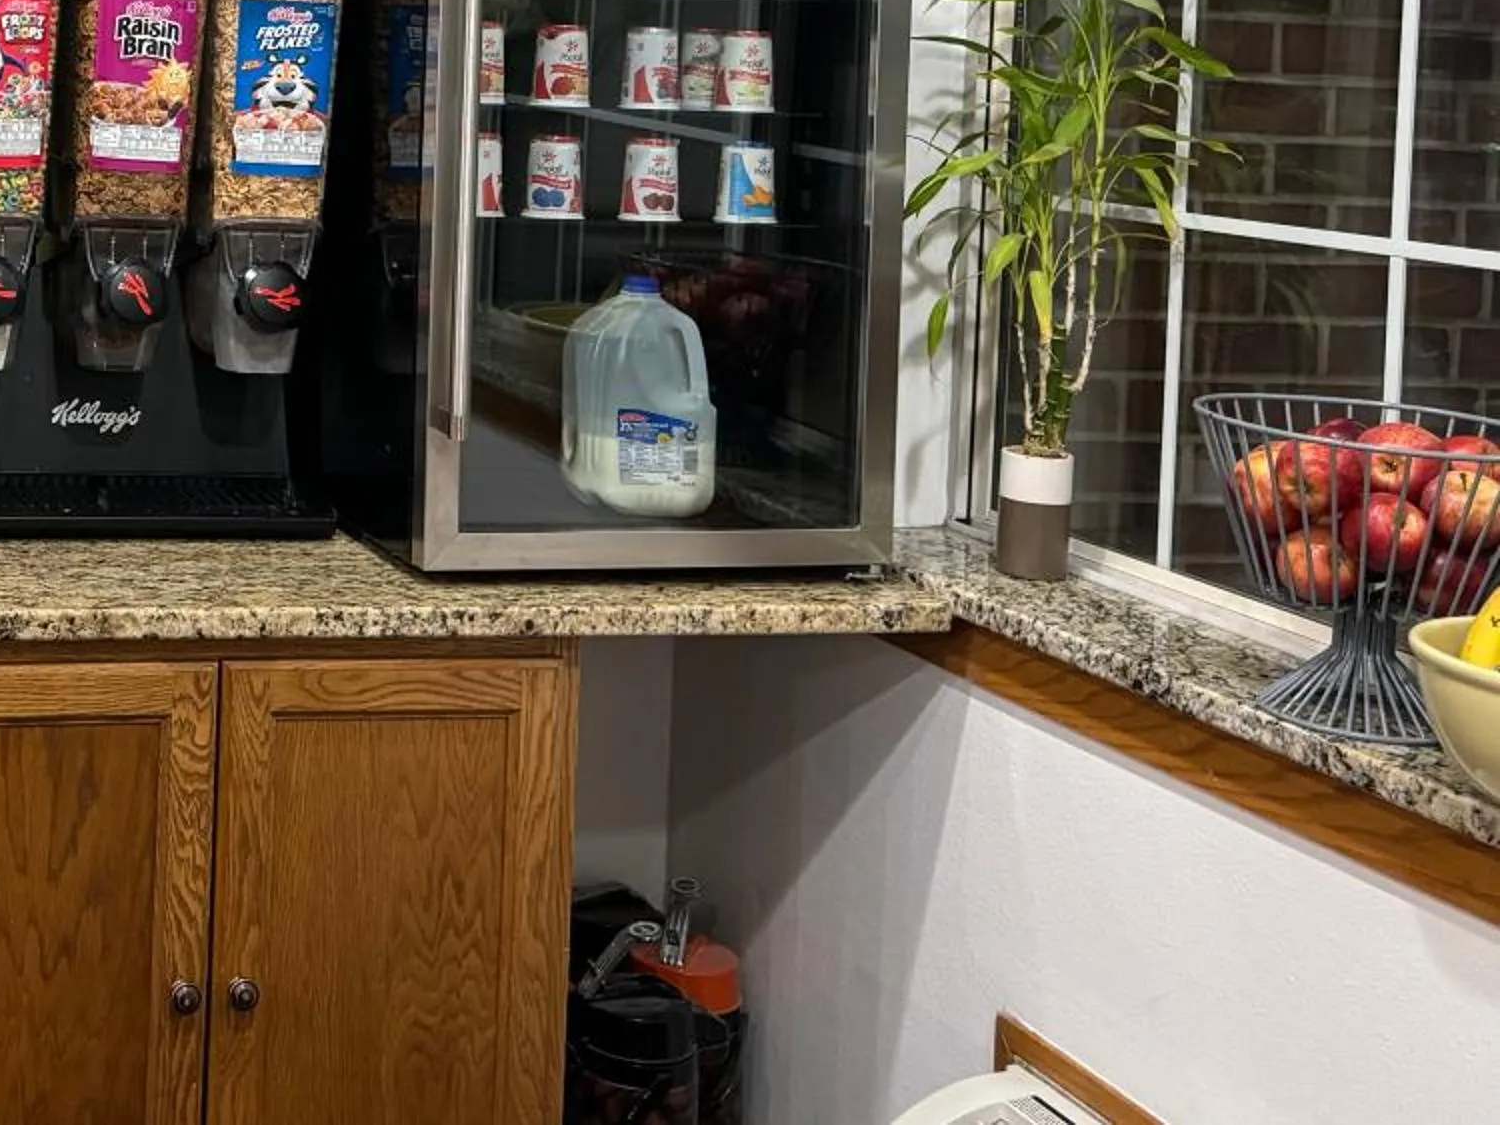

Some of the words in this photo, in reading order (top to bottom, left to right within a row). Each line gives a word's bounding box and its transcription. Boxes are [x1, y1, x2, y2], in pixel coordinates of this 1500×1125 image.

[116, 15, 180, 43] Raisin
[256, 23, 320, 40] FROSTED
[123, 36, 172, 59] Bran
[260, 37, 311, 51] FLAKES
[51, 397, 142, 433] Kellogg's
